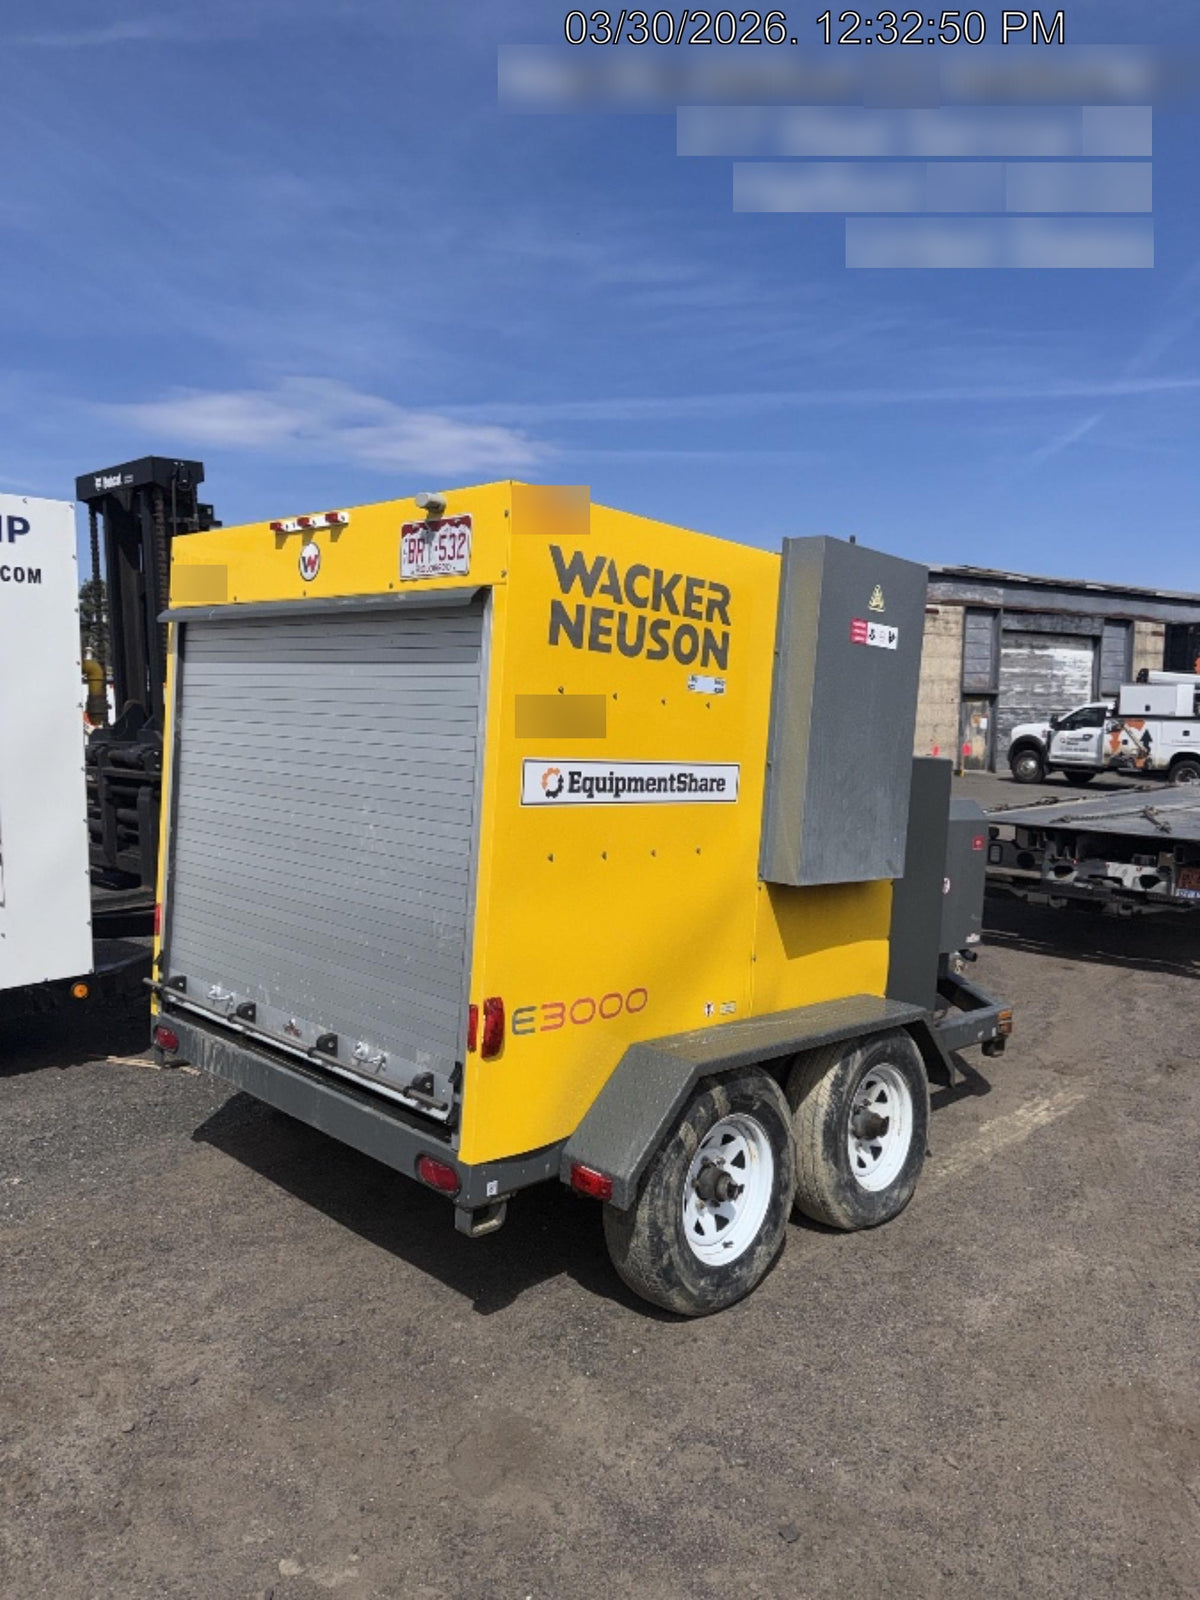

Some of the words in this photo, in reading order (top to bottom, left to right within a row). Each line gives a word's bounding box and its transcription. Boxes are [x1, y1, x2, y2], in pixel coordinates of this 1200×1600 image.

[548, 543, 731, 627] WACKER
[548, 599, 730, 671] NEUSON
[568, 771, 726, 798] EquipmentShare
[511, 988, 648, 1035] E3000
